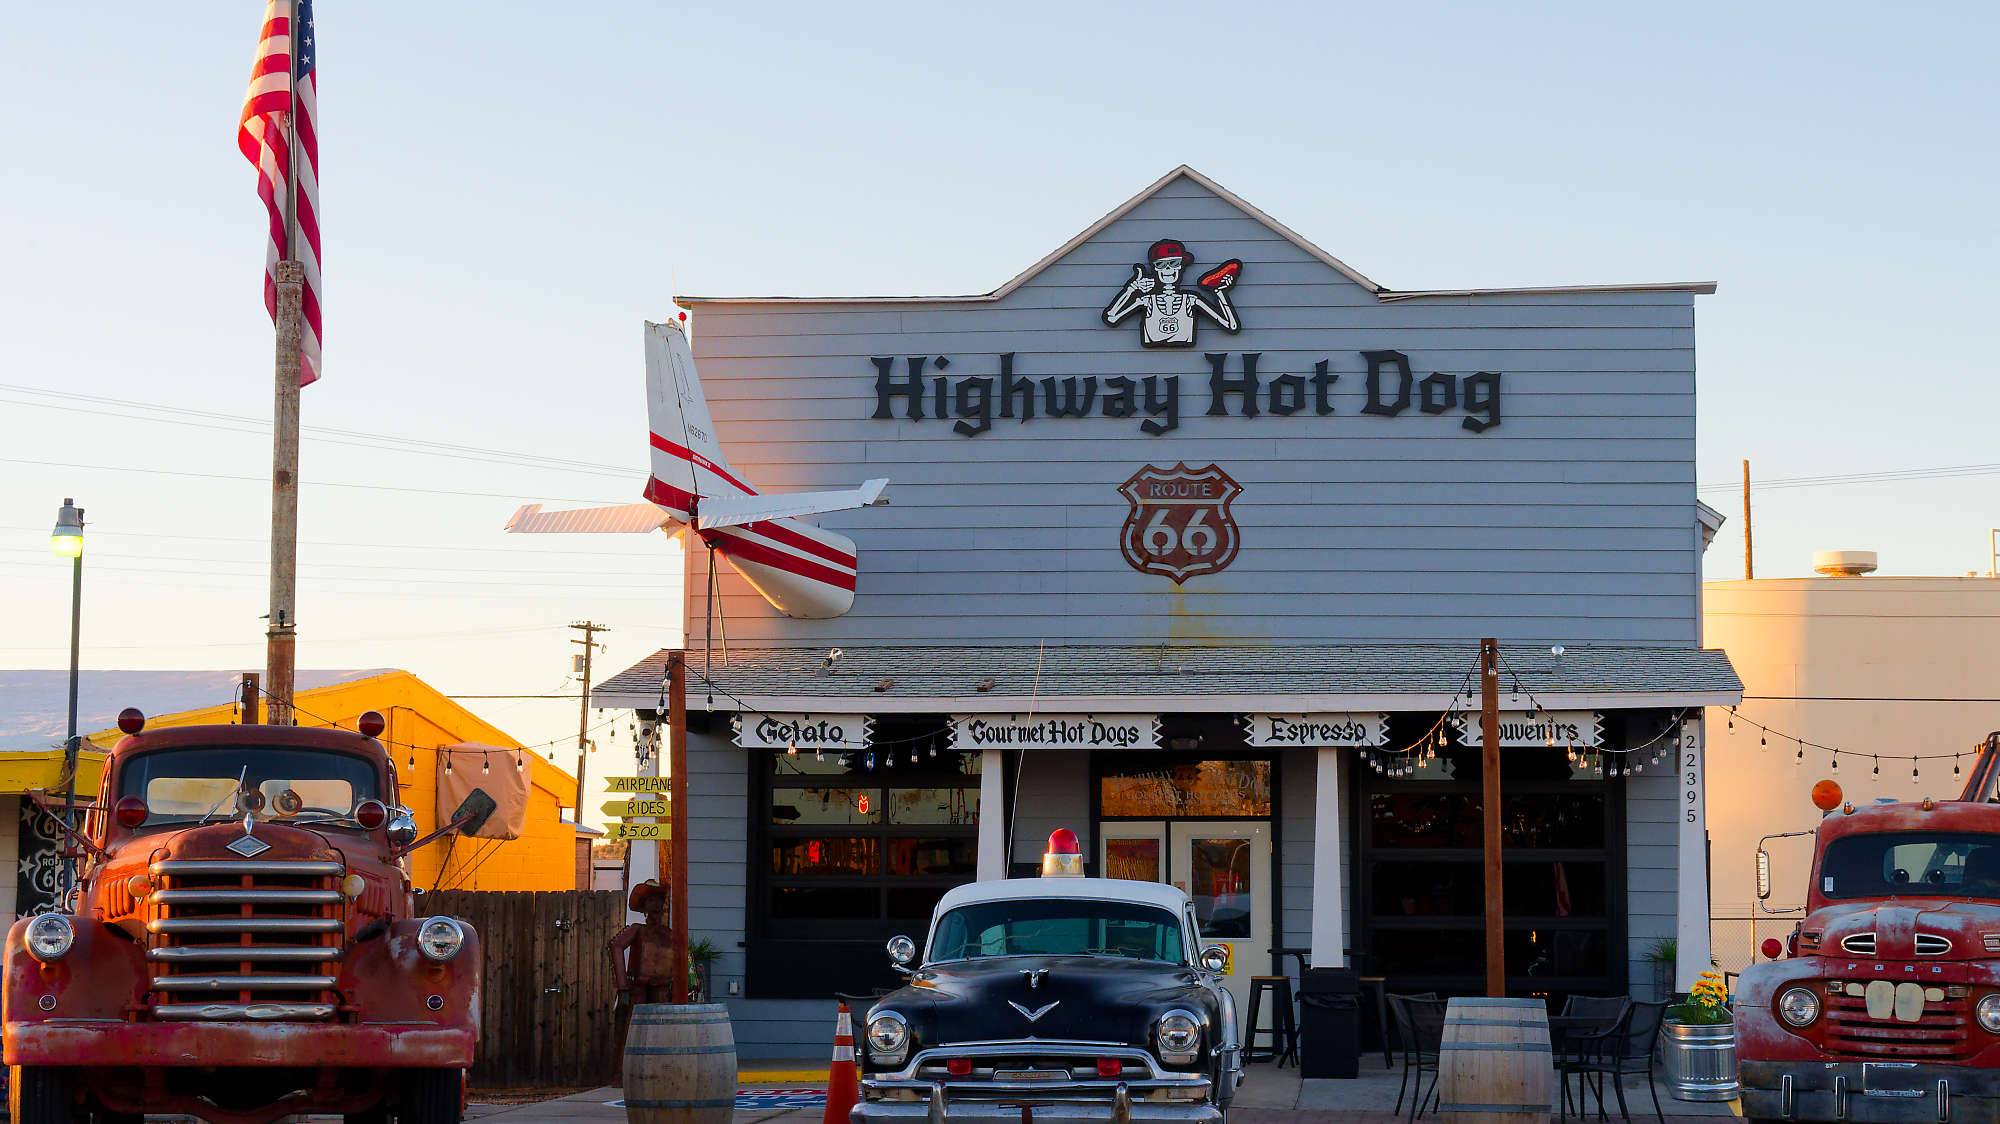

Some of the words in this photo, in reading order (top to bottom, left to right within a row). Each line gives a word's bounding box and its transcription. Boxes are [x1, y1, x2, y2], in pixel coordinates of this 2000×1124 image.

[870, 351, 1179, 437] Highway
[1204, 352, 1340, 419] Hot
[1360, 349, 1502, 433] Dog
[1150, 483, 1213, 497] ROUTE
[1143, 508, 1217, 557] 66
[756, 718, 844, 744] Gelato
[970, 719, 1045, 744] Gourmet
[1046, 719, 1085, 744] Hot
[1087, 719, 1140, 747] Dogs
[1265, 715, 1367, 744] Espresso
[1685, 735, 1697, 823] 22395
[627, 801, 665, 814] RIDES
[618, 824, 659, 838] $5.00
[42, 858, 65, 866] ROUT
[1848, 963, 1942, 973] FORD
